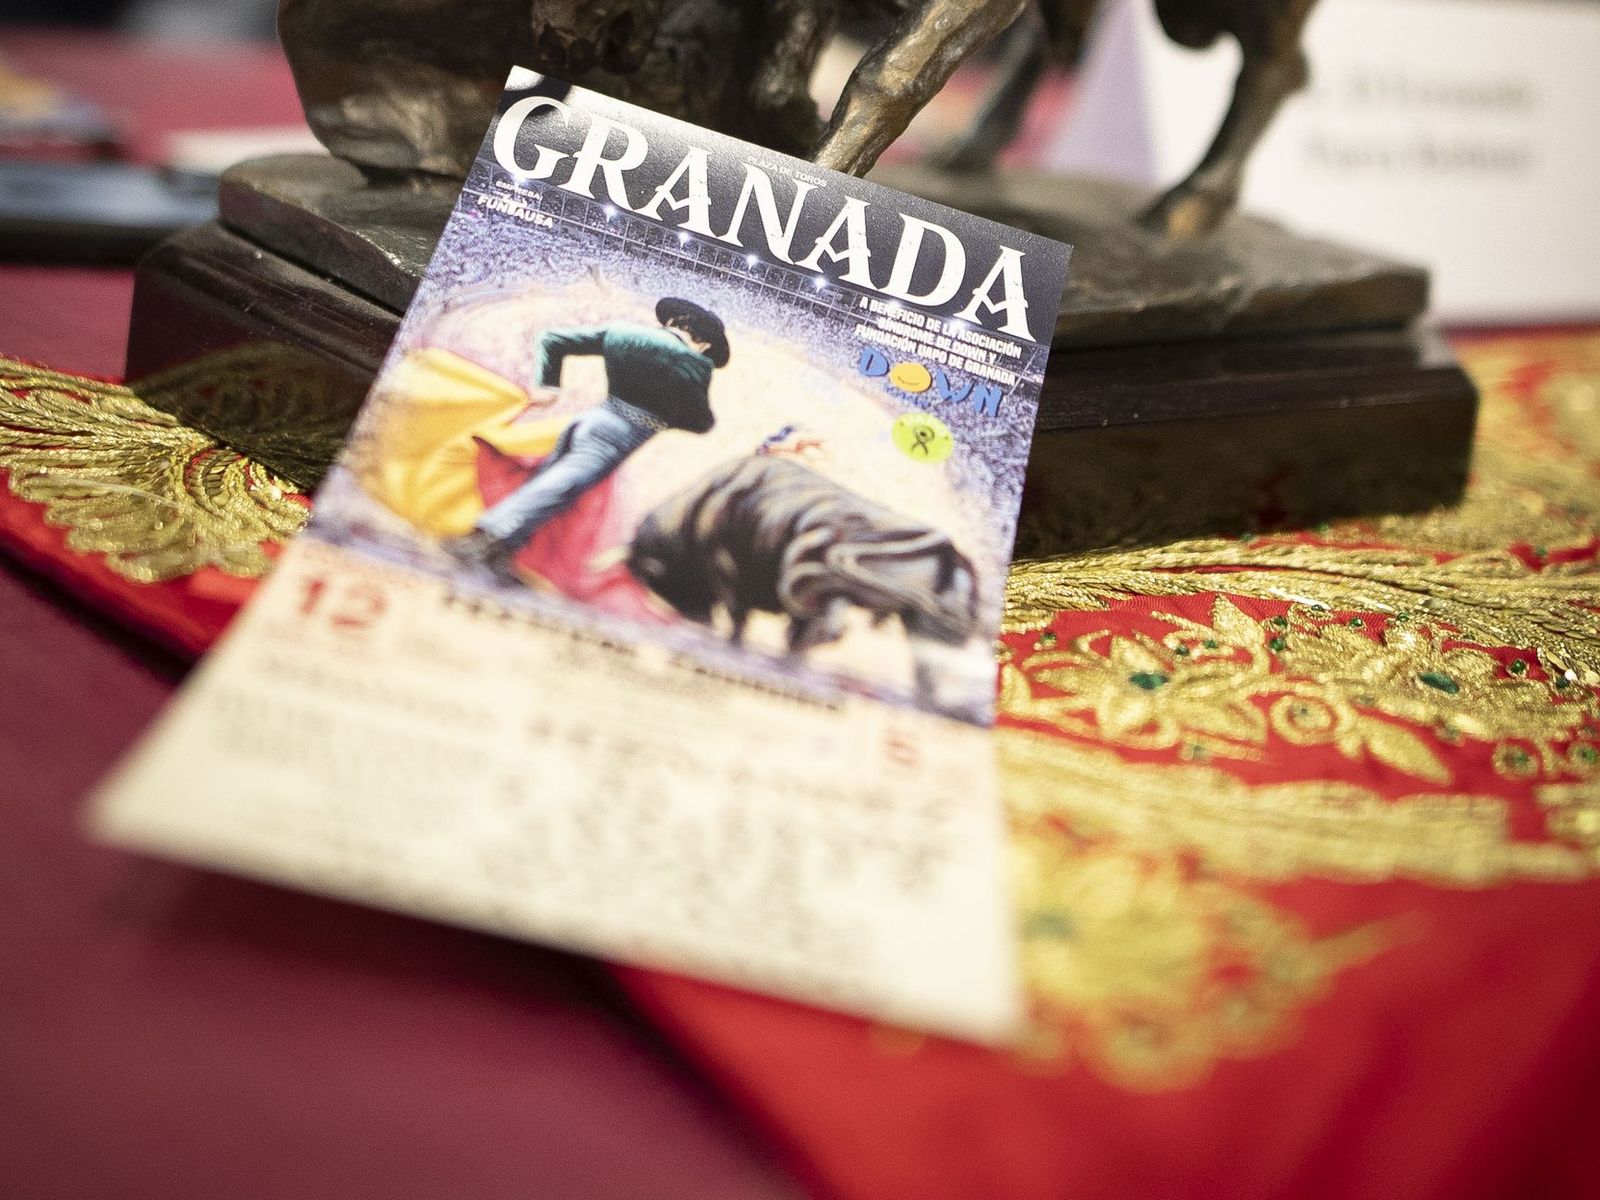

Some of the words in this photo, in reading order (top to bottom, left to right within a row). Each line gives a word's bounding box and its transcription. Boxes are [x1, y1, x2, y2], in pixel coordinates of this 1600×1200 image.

[794, 170, 827, 187] TOROS
[493, 95, 1037, 342] GRANADA
[859, 296, 868, 308] A
[869, 299, 925, 328] BENEFICIO
[925, 317, 941, 332] DE
[958, 327, 1022, 359] ASOCIACIÓN
[935, 334, 951, 350] DE
[951, 340, 987, 362] DOWN
[986, 351, 996, 364] Y
[947, 353, 964, 368] DE
[963, 358, 1016, 386] GRANADA
